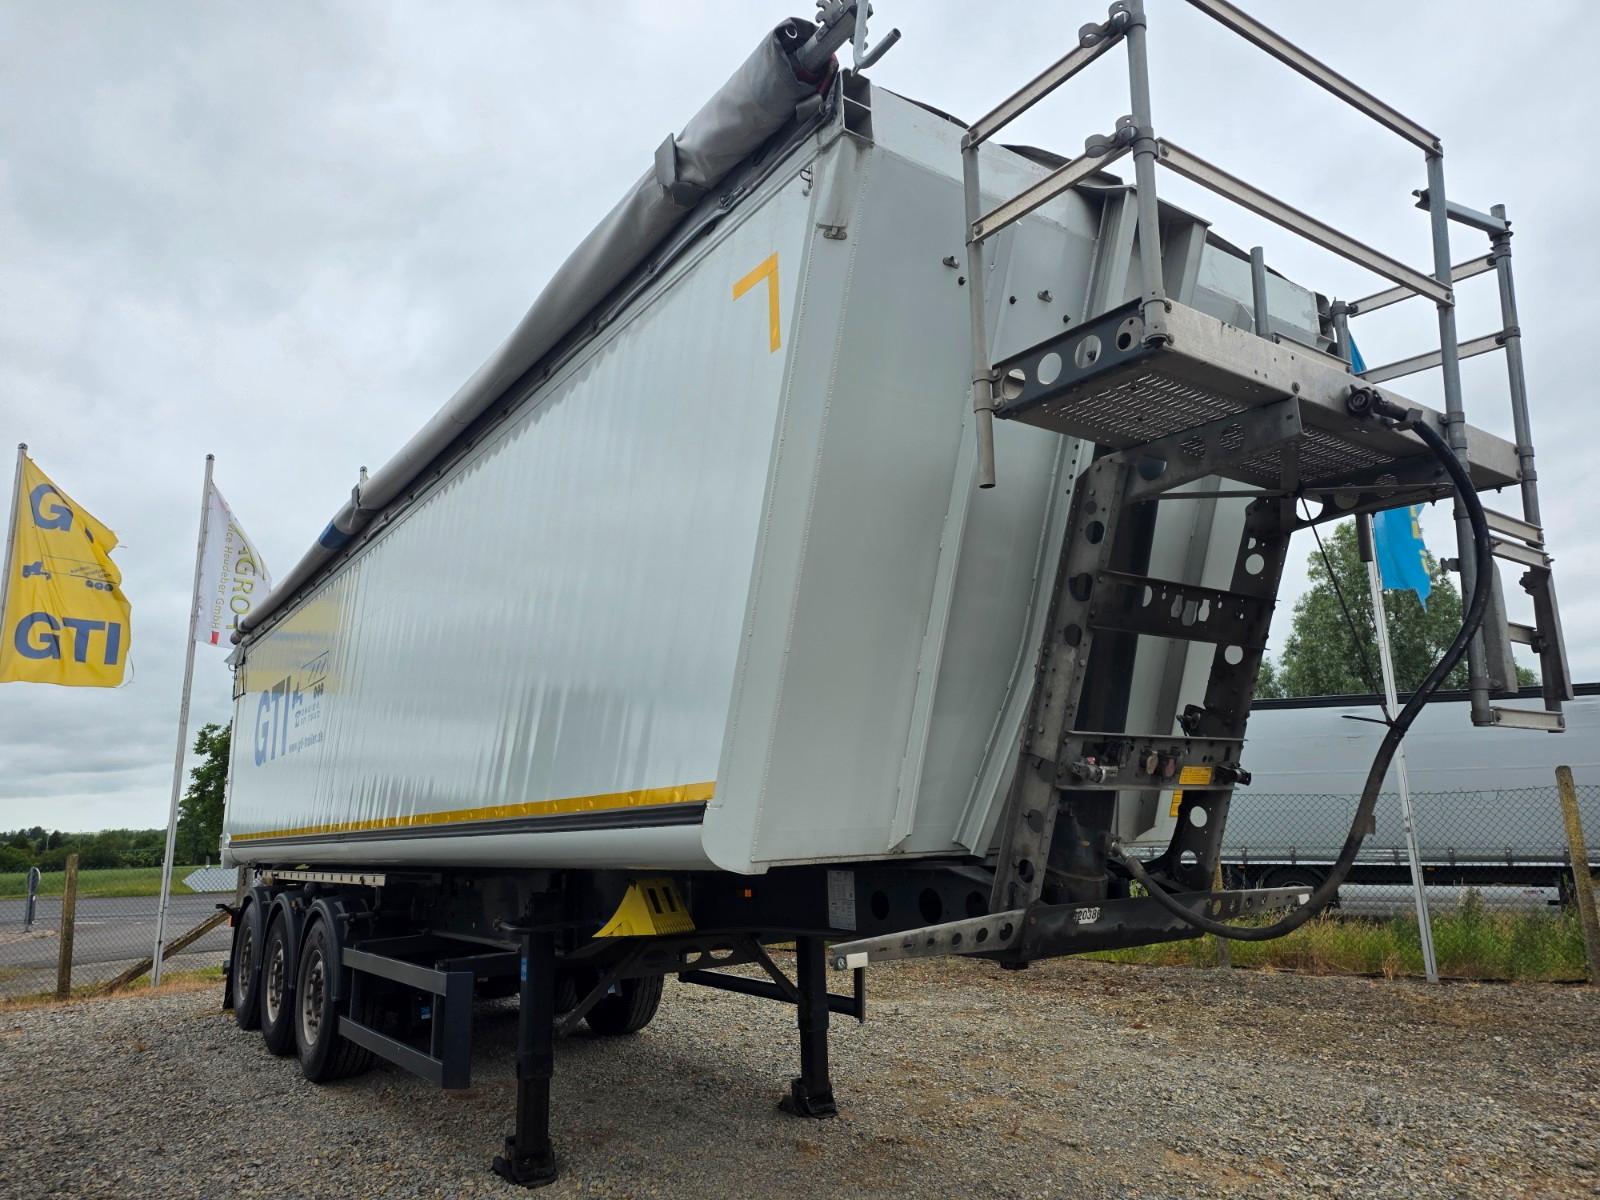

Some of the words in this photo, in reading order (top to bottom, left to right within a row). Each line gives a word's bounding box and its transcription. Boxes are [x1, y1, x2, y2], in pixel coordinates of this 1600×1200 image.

[14, 611, 121, 666] GTI
[211, 598, 225, 629] GmbH
[255, 675, 291, 767] GTI
